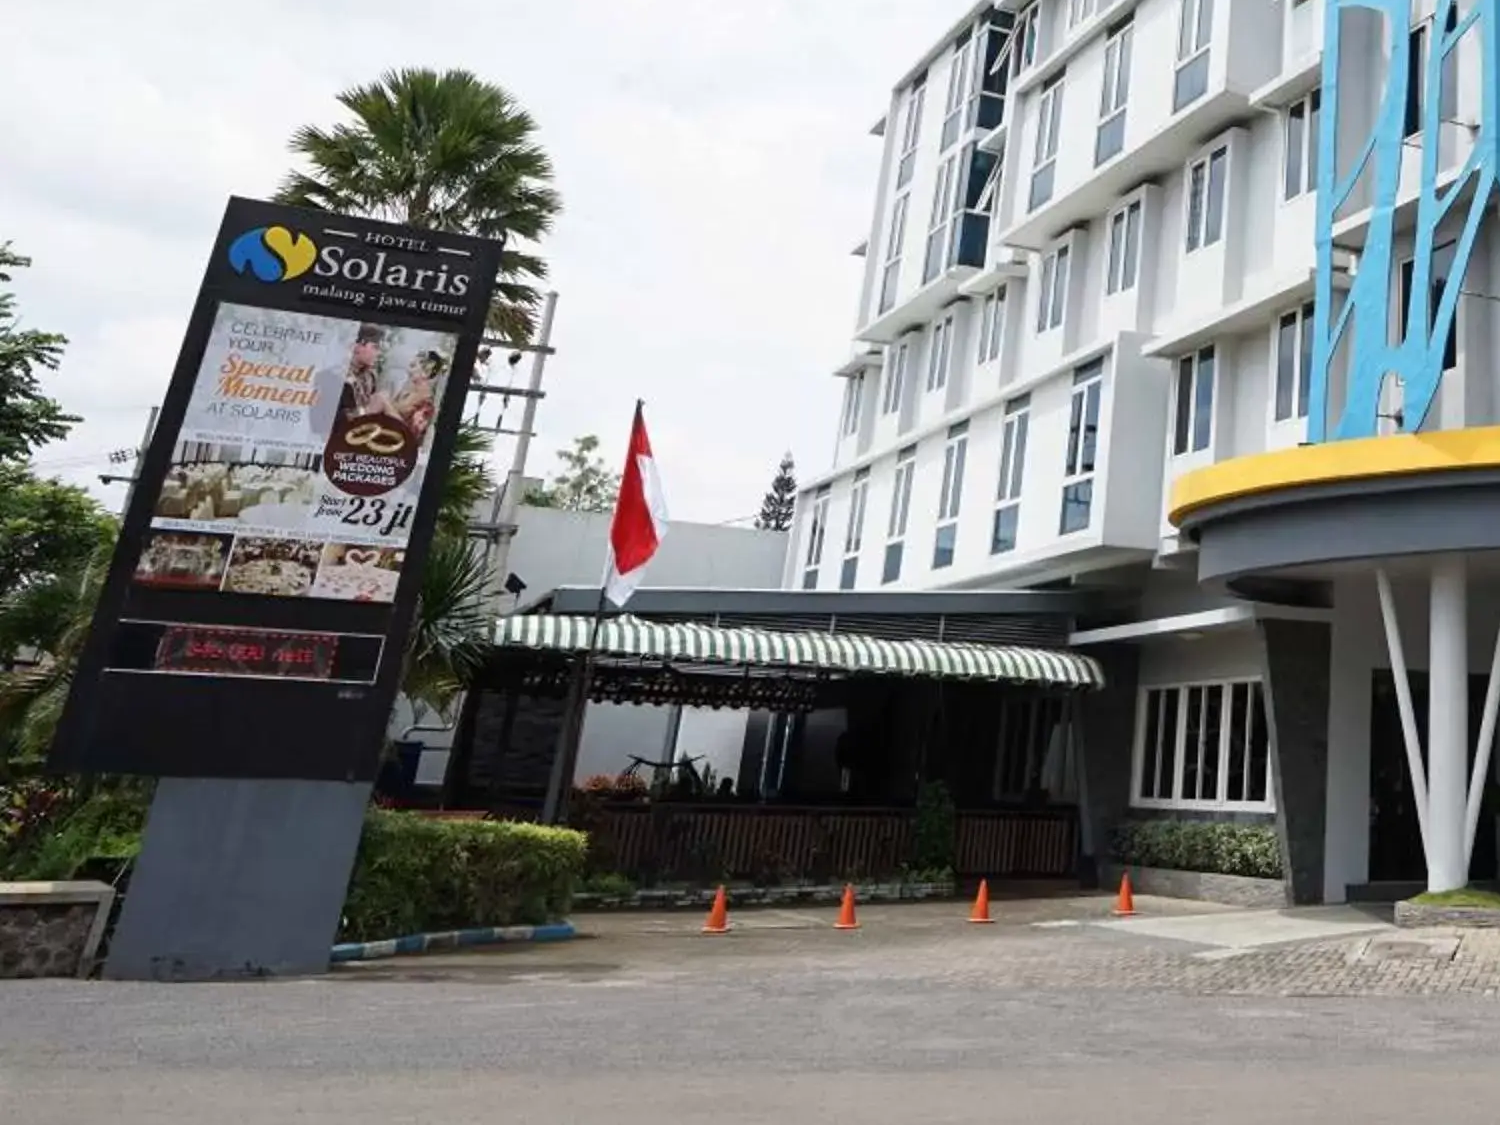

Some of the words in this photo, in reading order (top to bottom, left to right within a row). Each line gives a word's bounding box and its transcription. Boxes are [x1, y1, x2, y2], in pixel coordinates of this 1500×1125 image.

[364, 231, 429, 253] HOTEL
[313, 245, 470, 296] Solaris
[302, 283, 366, 306] malang
[377, 292, 417, 309] jawa
[420, 299, 467, 316] timur
[228, 337, 277, 353] YOUR
[231, 321, 324, 345] CELEBRATE
[219, 352, 315, 384] Special
[214, 375, 322, 406] Moment
[205, 402, 227, 414] AT
[230, 403, 302, 424] SOLARIS
[332, 470, 396, 486] PACKAGES
[339, 461, 395, 476] WEDDING
[342, 496, 387, 526] 23
